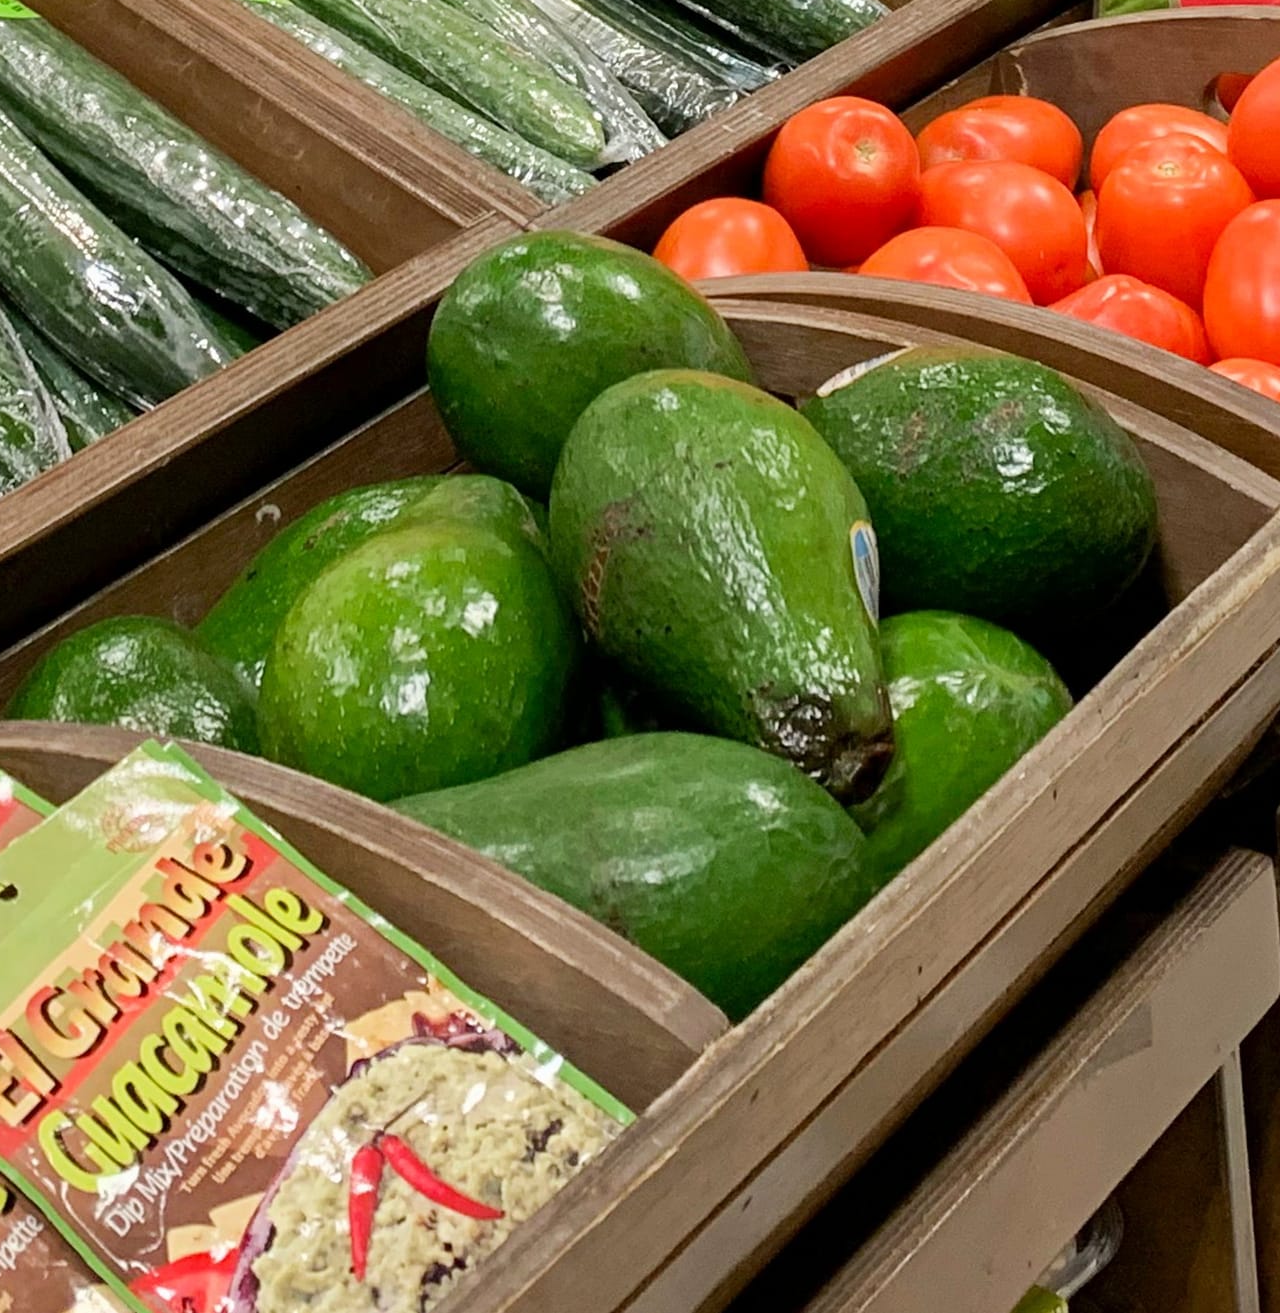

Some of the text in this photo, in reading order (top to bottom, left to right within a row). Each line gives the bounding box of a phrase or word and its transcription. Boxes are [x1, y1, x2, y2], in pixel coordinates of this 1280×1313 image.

[26, 831, 255, 1062] Grande
[39, 881, 332, 1193] Guacamole
[104, 933, 357, 1237] Dip Mix/Préparation de trempette
